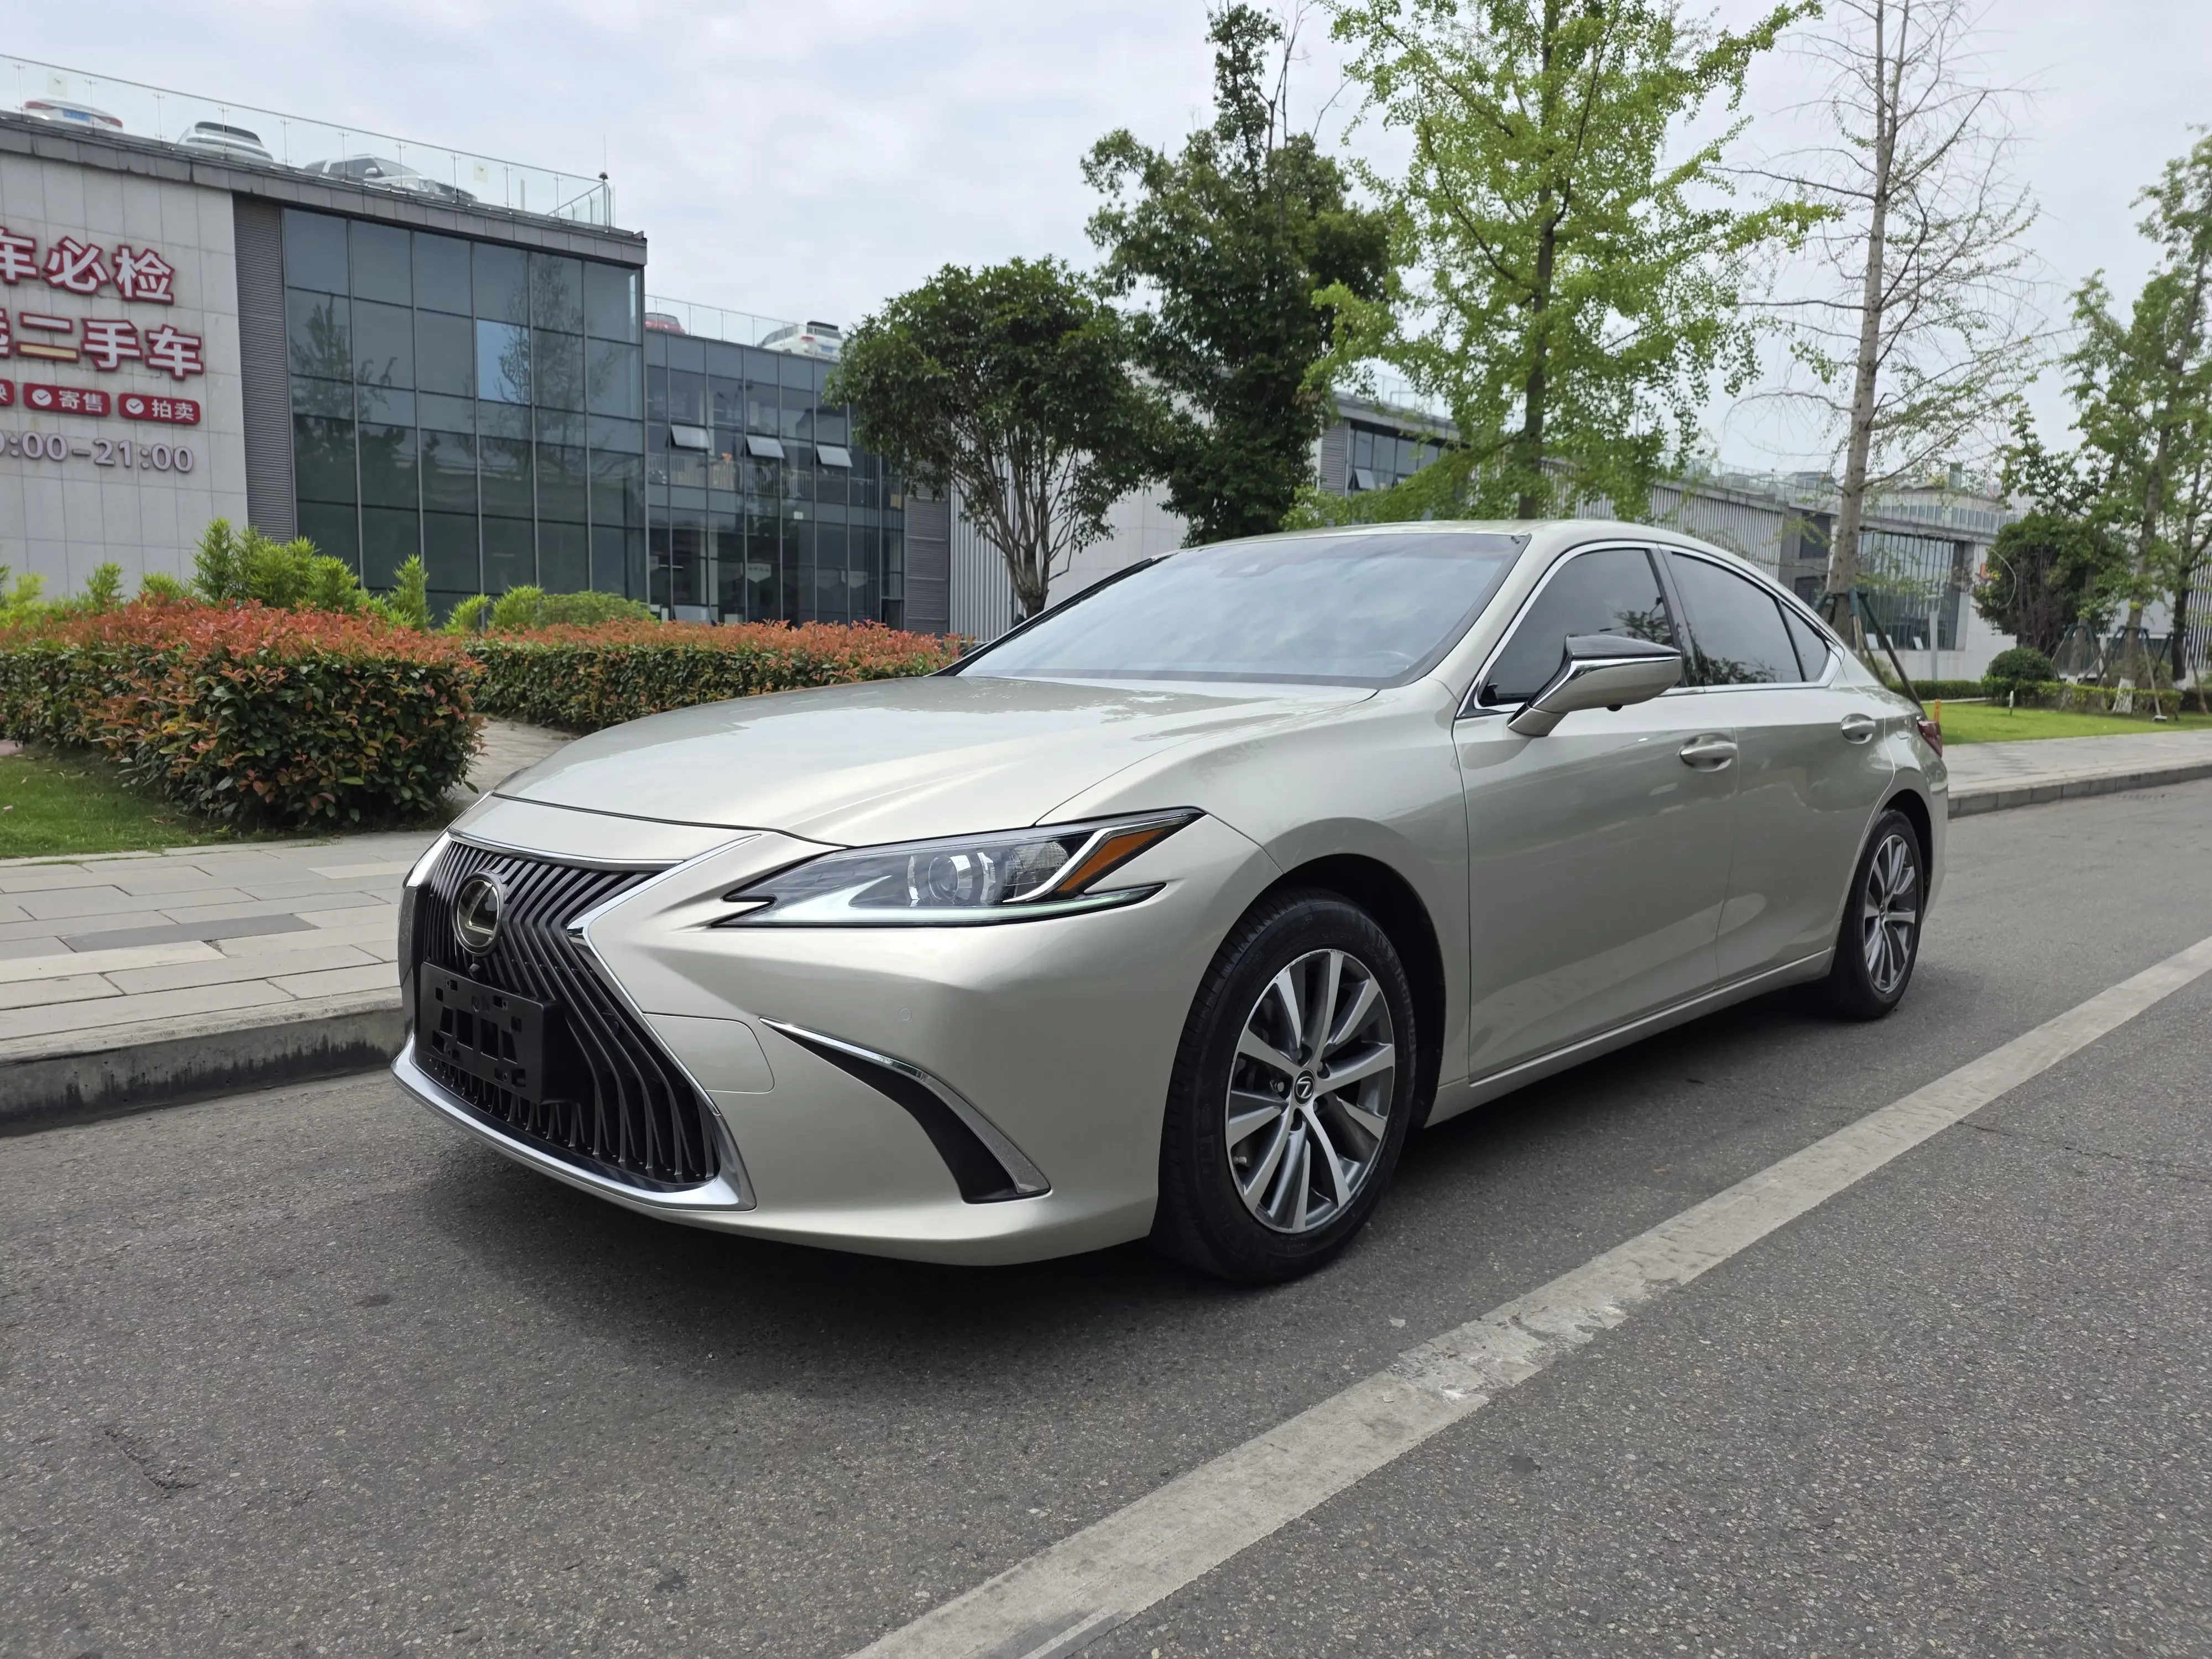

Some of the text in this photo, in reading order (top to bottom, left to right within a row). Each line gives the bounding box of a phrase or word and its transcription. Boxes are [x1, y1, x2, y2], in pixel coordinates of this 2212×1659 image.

[0, 226, 175, 305] 车必检
[0, 308, 204, 380] 二手车
[59, 389, 194, 421] 寄售 拍卖
[0, 427, 194, 473] :00-21:00
